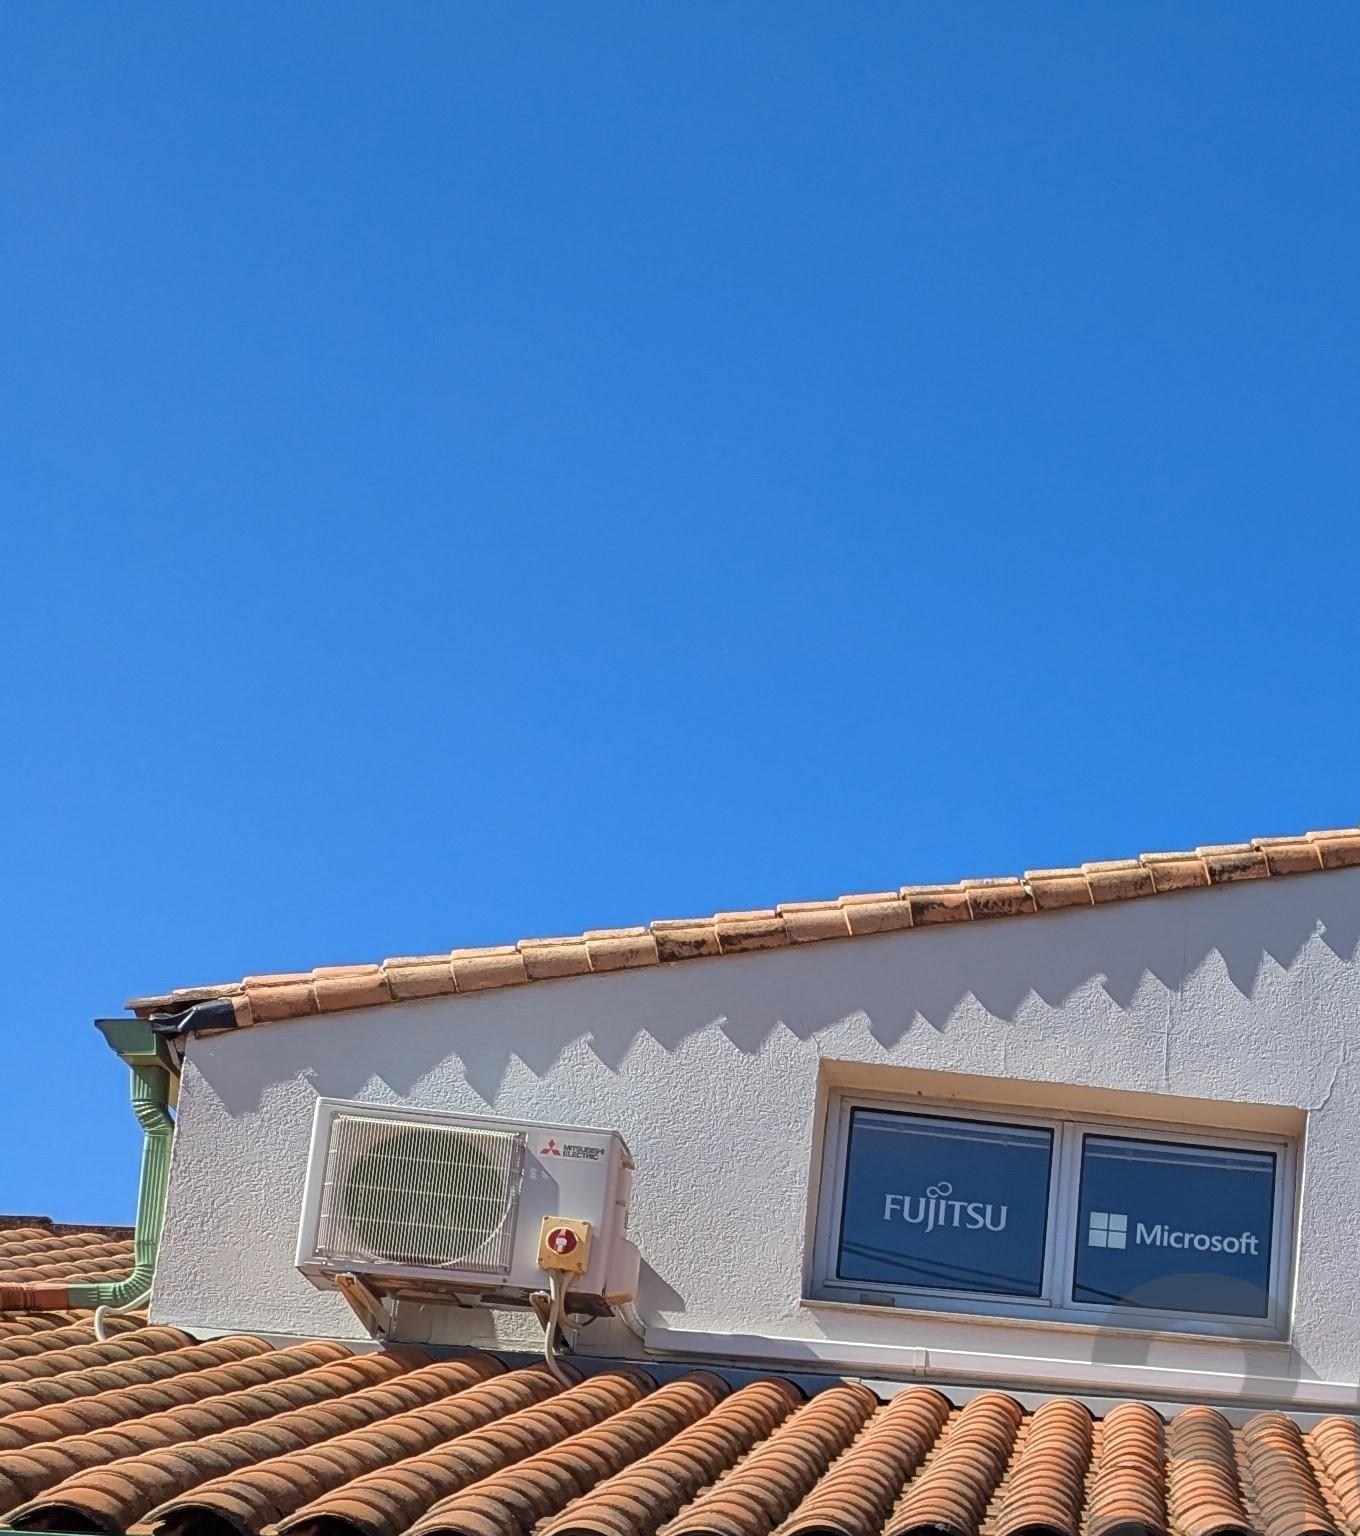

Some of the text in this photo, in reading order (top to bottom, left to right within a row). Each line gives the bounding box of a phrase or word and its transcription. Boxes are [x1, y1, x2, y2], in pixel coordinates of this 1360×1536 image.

[563, 1144, 605, 1155] MITSUBISHI
[563, 1151, 598, 1160] ELECTRIC
[884, 1182, 1008, 1232] FUJITSU
[1135, 1223, 1259, 1255] Microsoft
